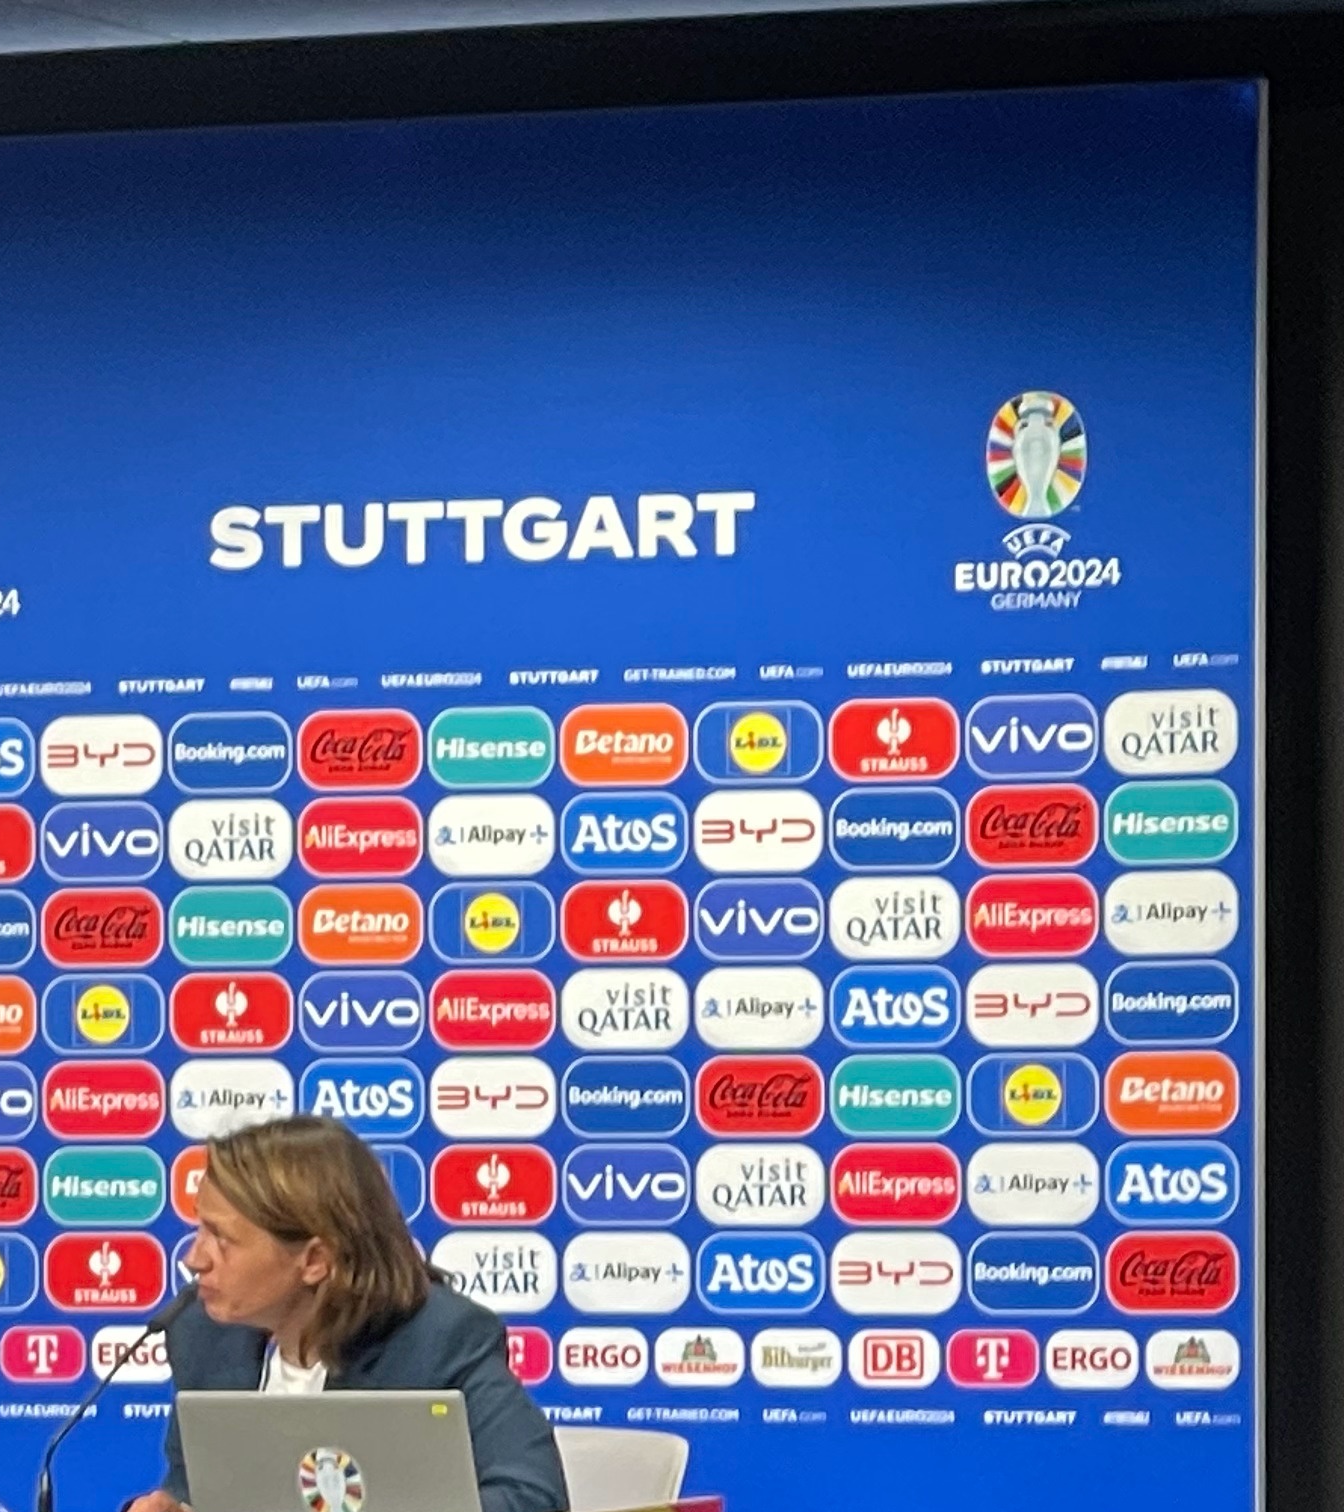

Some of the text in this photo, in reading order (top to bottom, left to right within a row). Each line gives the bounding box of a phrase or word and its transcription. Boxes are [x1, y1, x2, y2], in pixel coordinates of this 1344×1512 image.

[209, 491, 755, 571] STUTTGART
[954, 558, 1121, 591] EURO2024
[991, 590, 1082, 610] GERMANY
[509, 669, 599, 686] STUTTGART
[981, 657, 1075, 674] STUTTGART
[118, 677, 206, 694] STUTTGART
[575, 727, 674, 755] Betano
[971, 715, 1092, 752] vivo
[174, 740, 285, 765] Booking.com
[861, 756, 927, 772] STRAUSS
[211, 812, 275, 836] visit
[701, 818, 814, 843] BYD
[1113, 810, 1229, 834] Hisense
[305, 822, 417, 854] AliExpress
[184, 837, 274, 865] QATAR
[177, 914, 285, 937] Hisense
[605, 981, 671, 1005] visit
[303, 991, 419, 1026] vivo
[578, 1007, 671, 1034] QATAR
[49, 1086, 159, 1116] AliExpress
[437, 1085, 548, 1109] BYD
[1121, 1075, 1223, 1102] Betano
[51, 1175, 158, 1197] Hisense
[838, 1170, 954, 1201] AliExpress
[974, 1262, 1091, 1285] Booking.com
[74, 1288, 136, 1303] STRAUSS
[565, 1344, 641, 1369] ERGO
[871, 1343, 917, 1373] DB
[1053, 1346, 1132, 1371] ERGO
[983, 1409, 1077, 1426] STUTTGART
